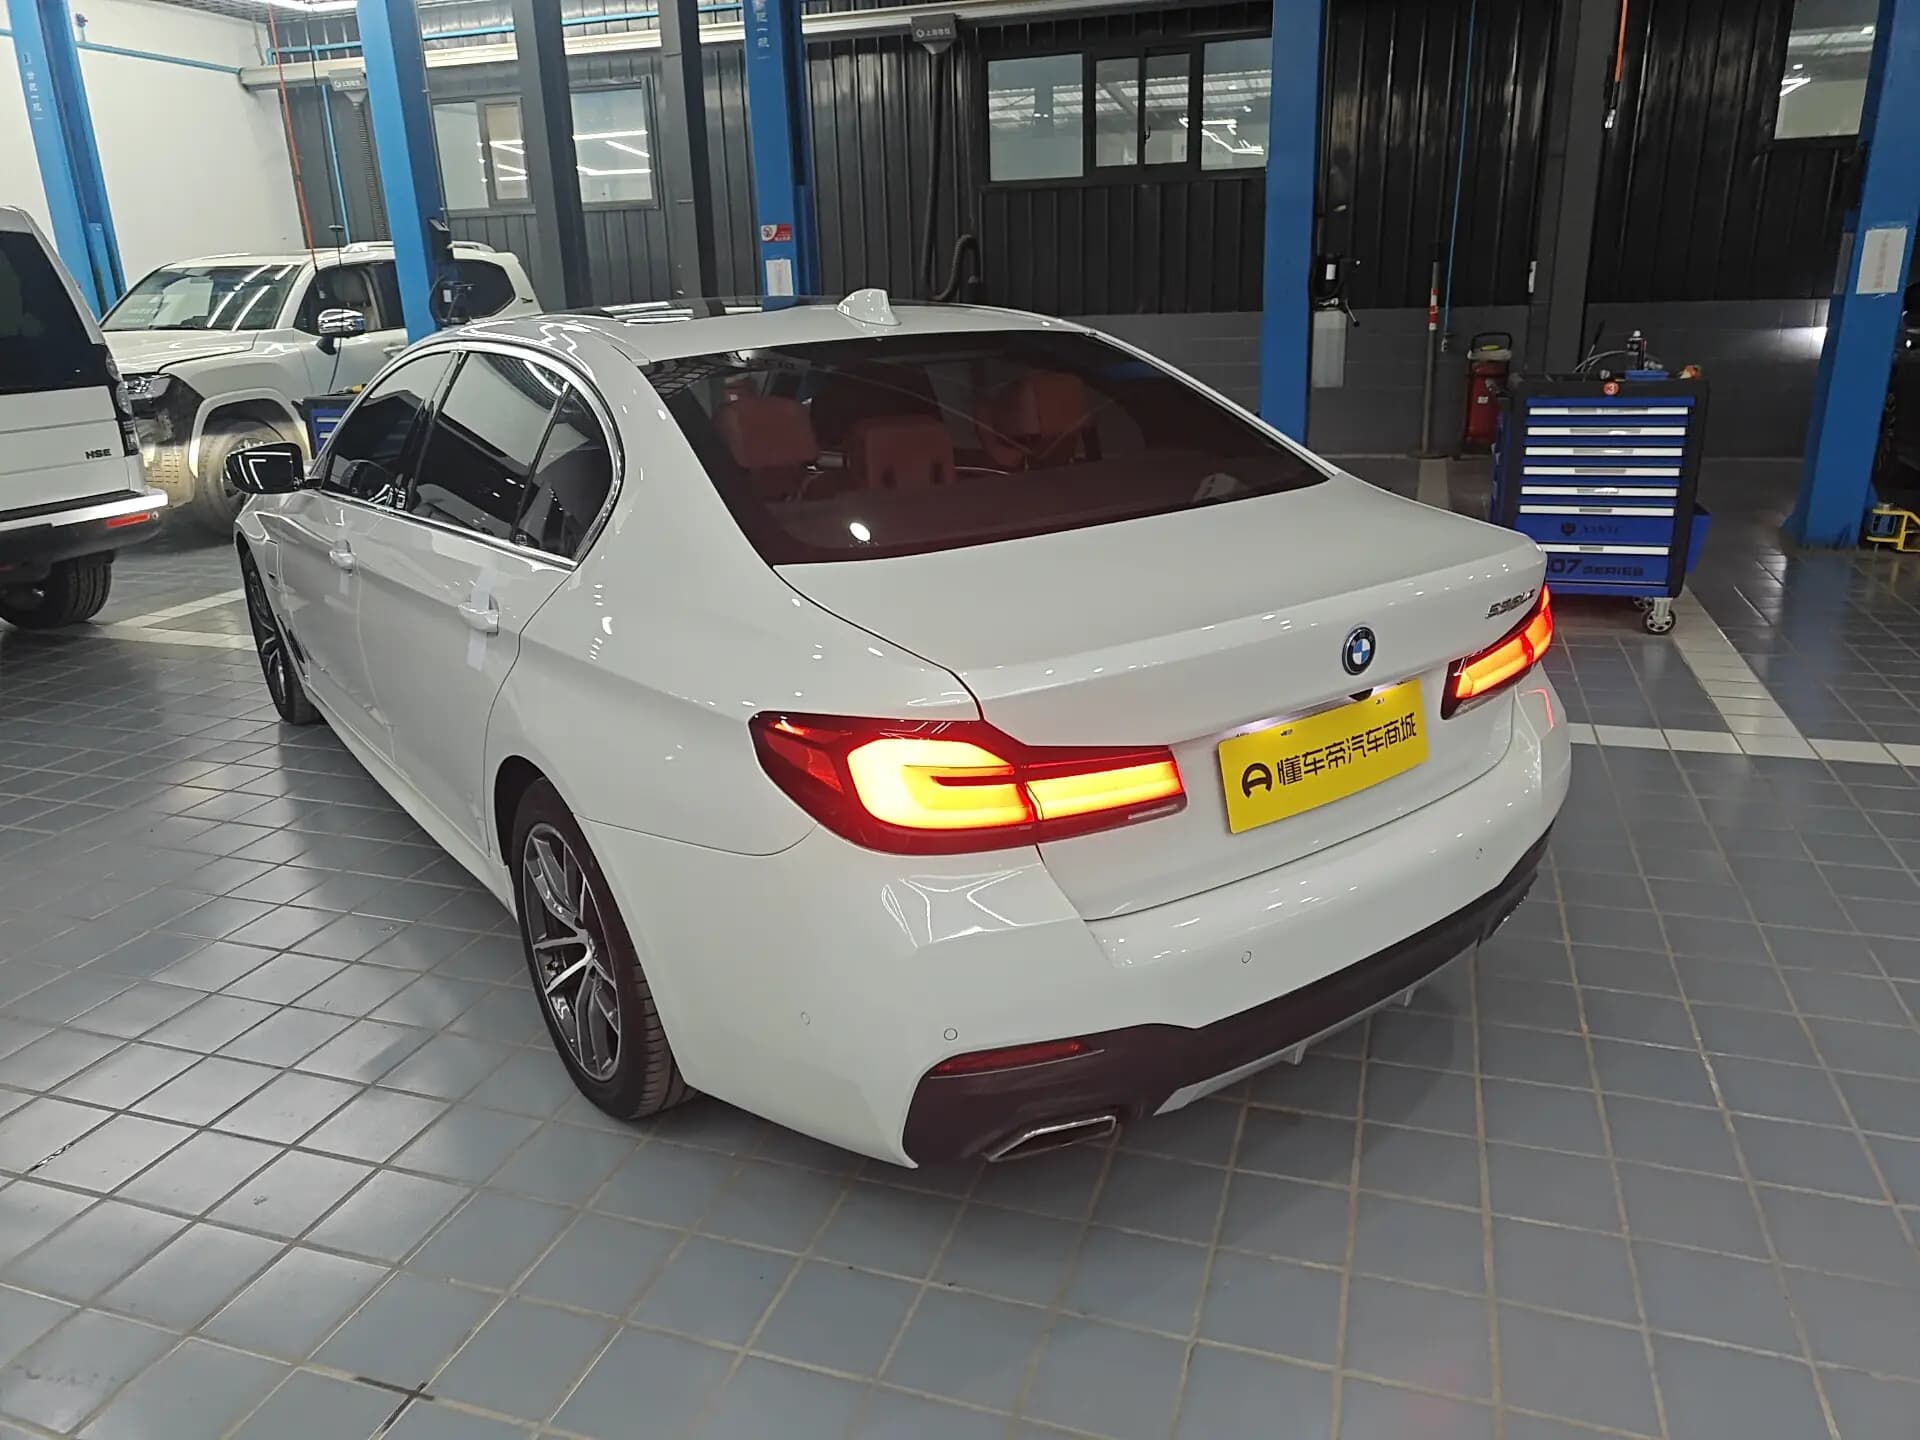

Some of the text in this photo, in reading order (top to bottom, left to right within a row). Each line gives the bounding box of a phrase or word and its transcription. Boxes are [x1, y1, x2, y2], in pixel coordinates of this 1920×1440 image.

[85, 448, 112, 459] HSE
[1277, 712, 1417, 785] 懂车帝汽车商城
